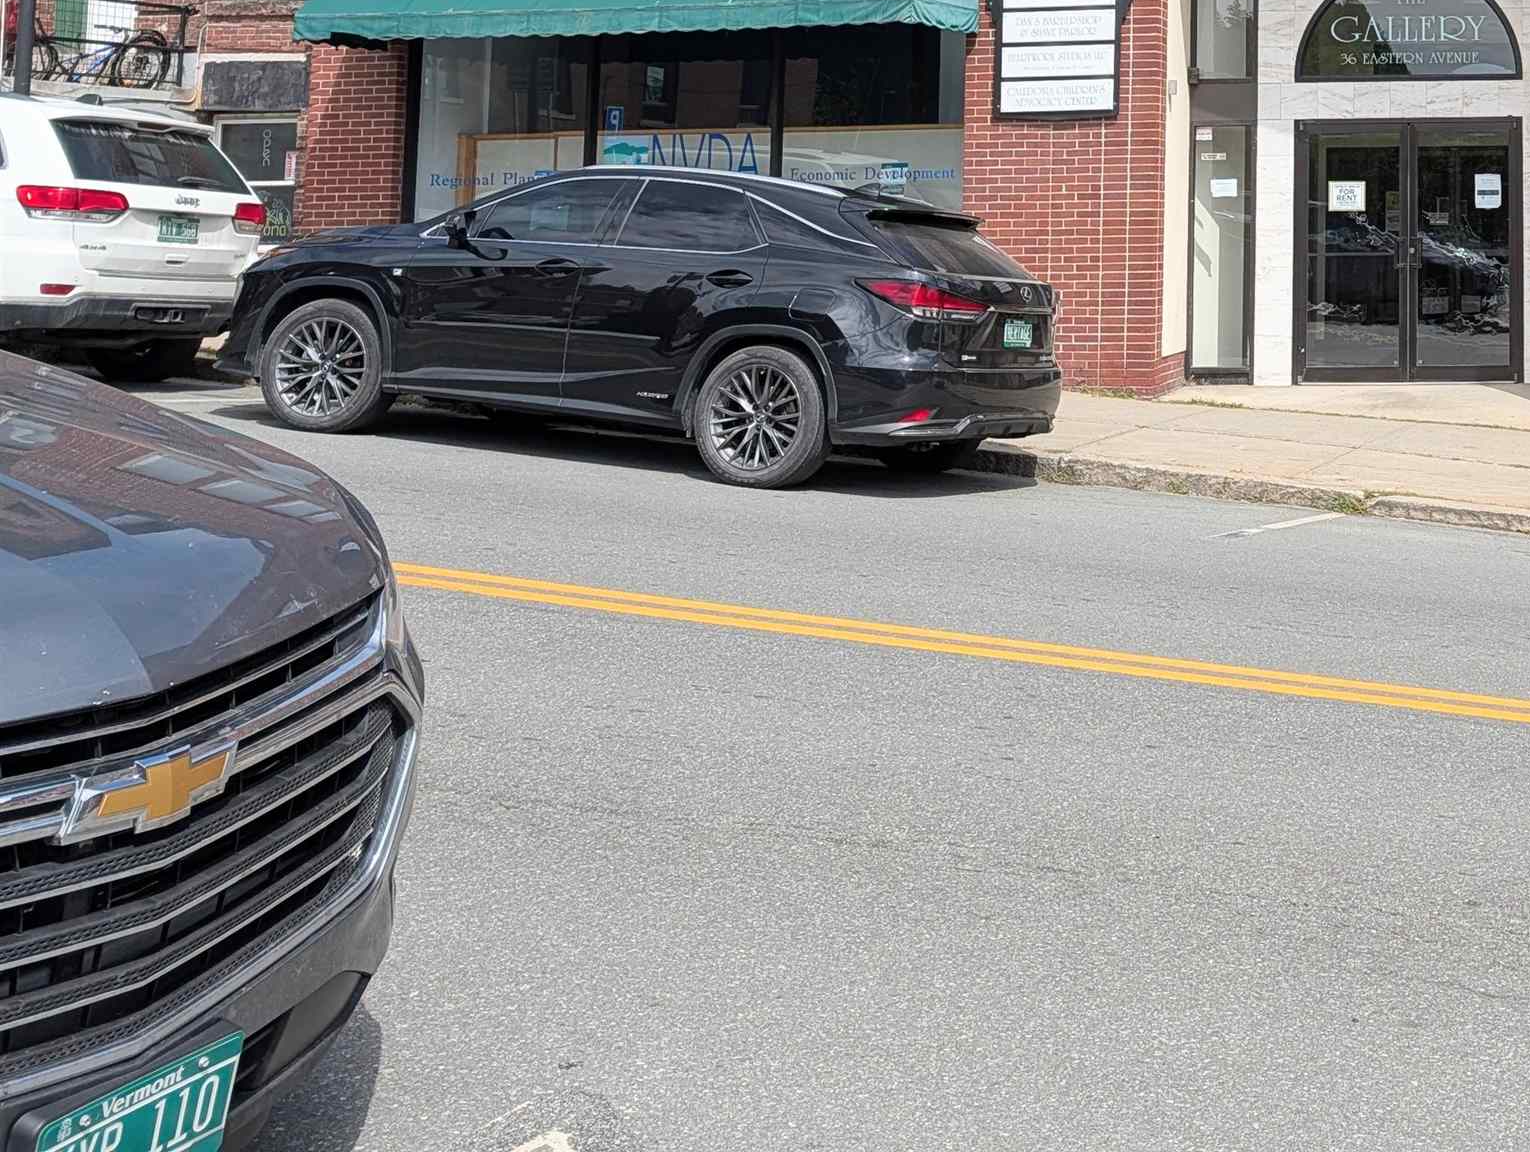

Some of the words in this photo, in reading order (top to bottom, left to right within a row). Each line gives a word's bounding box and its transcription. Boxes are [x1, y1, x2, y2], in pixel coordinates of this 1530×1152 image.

[1330, 15, 1488, 44] GALLERY
[1340, 52, 1358, 66] 36
[1362, 52, 1424, 65] EASTERN
[1428, 51, 1480, 64] AVENUE
[651, 132, 758, 175] NVDA
[429, 172, 495, 189] Regional
[503, 171, 541, 185] Plan
[790, 167, 857, 182] Economic
[864, 166, 956, 182] Development
[101, 1065, 185, 1118] Vermont
